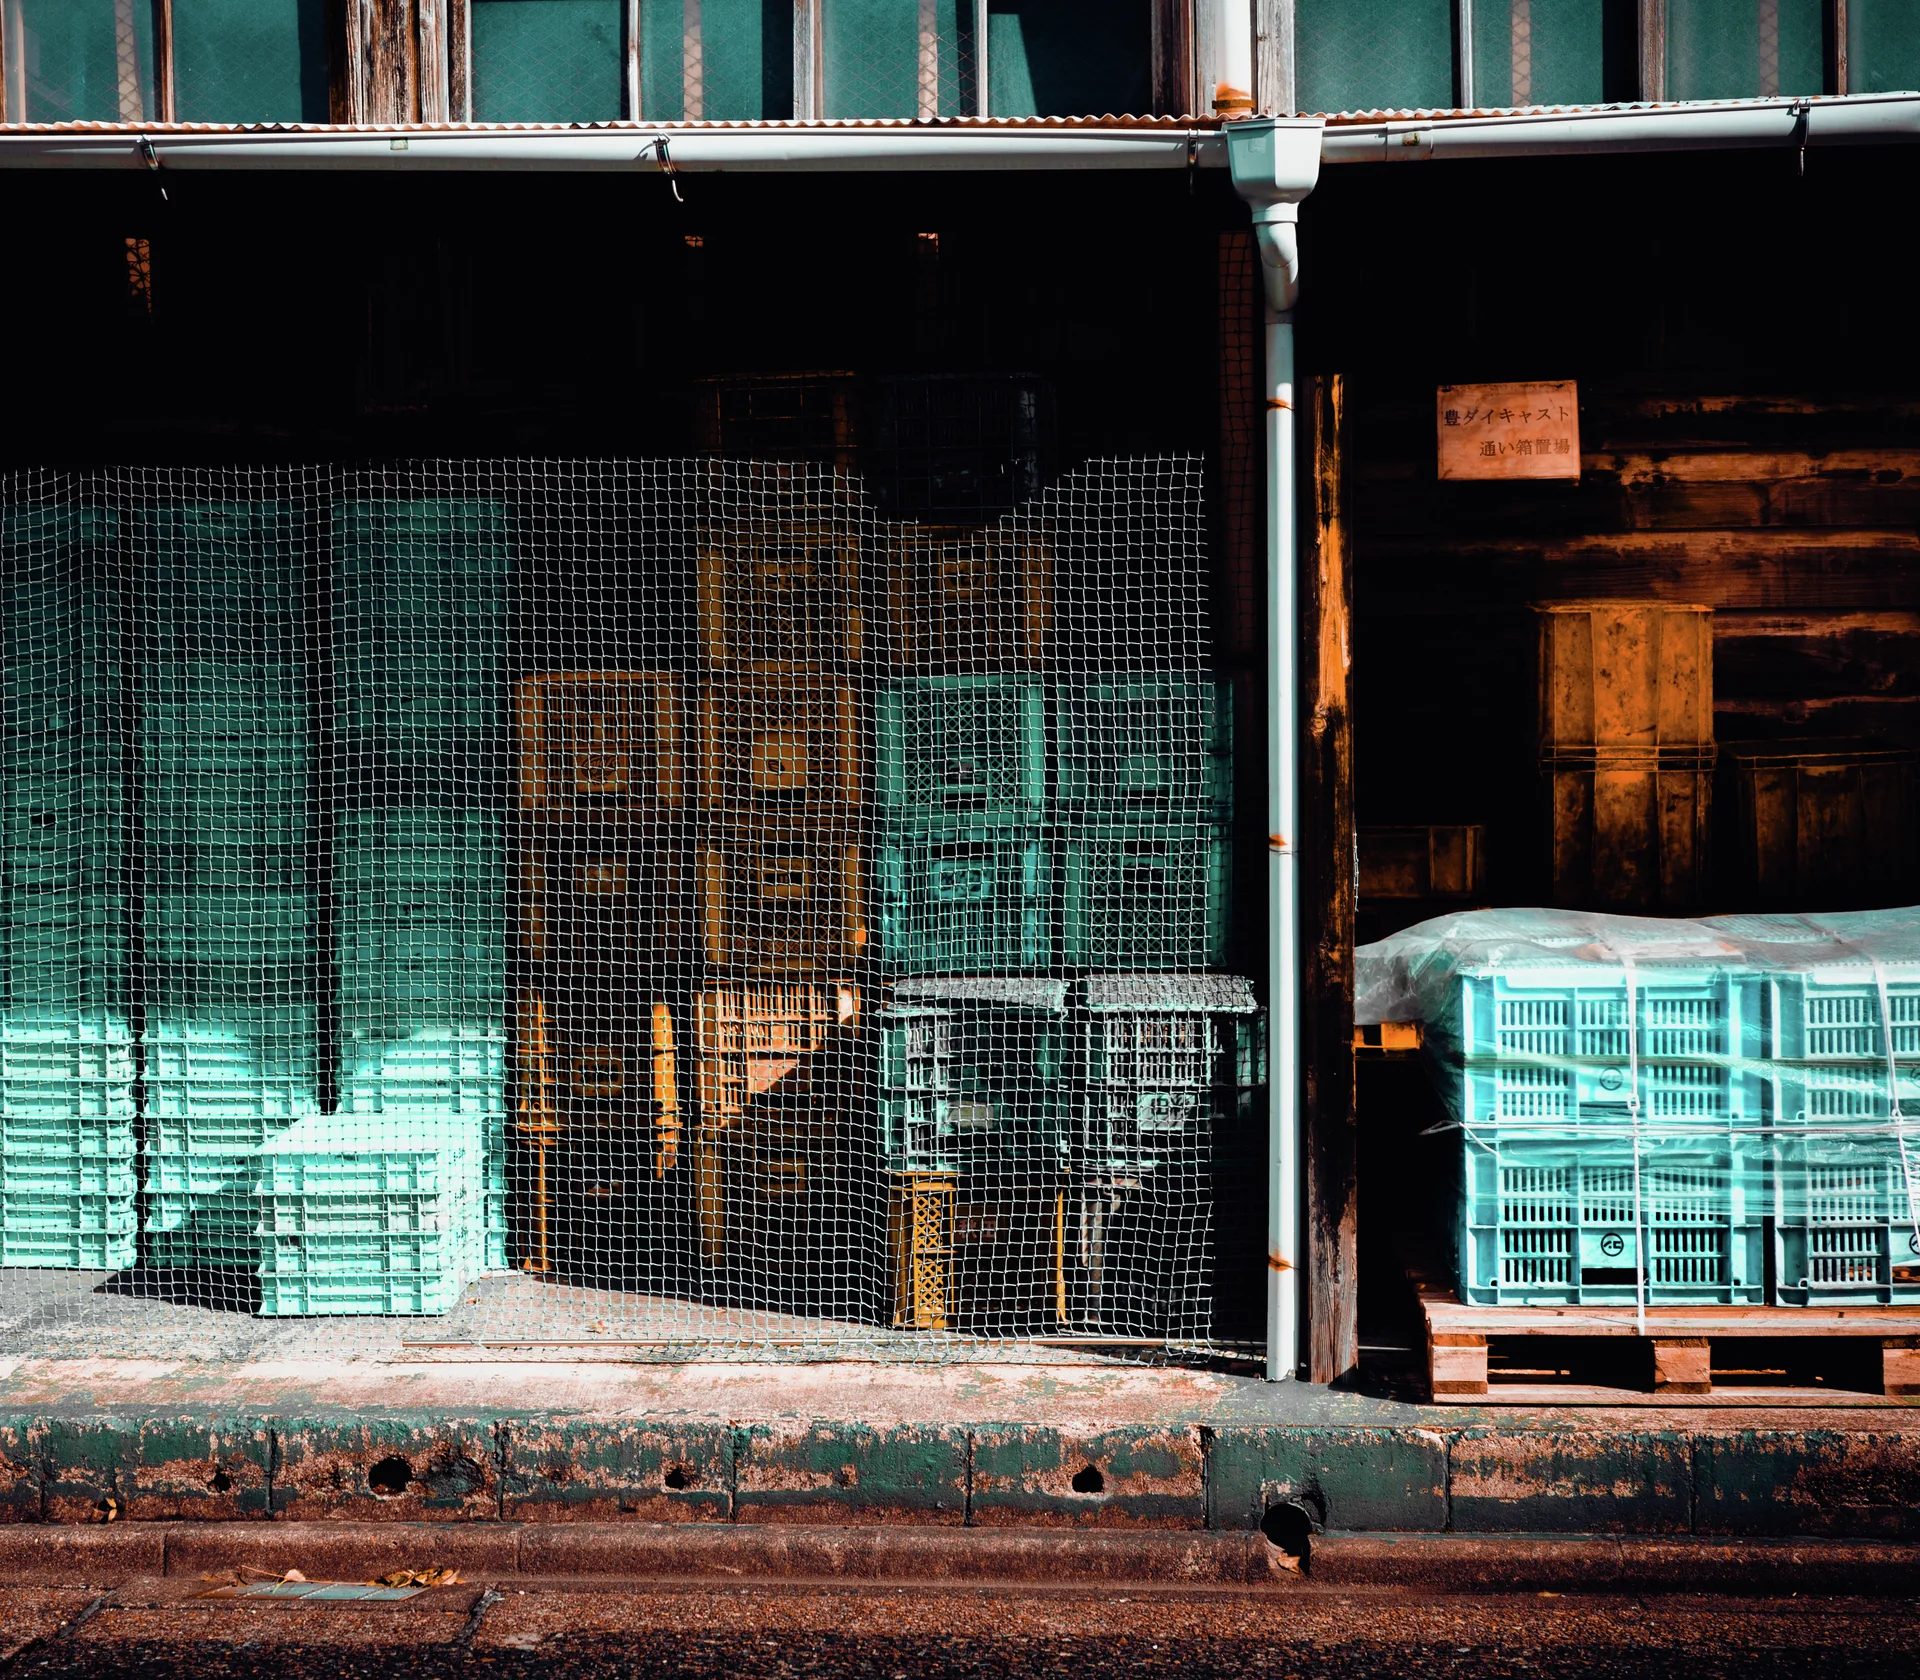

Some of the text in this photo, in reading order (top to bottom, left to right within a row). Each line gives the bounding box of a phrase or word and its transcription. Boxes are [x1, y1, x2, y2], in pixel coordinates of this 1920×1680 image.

[1444, 406, 1569, 426] 豊ダイキャスト
[1480, 438, 1570, 457] 通い箱置場
